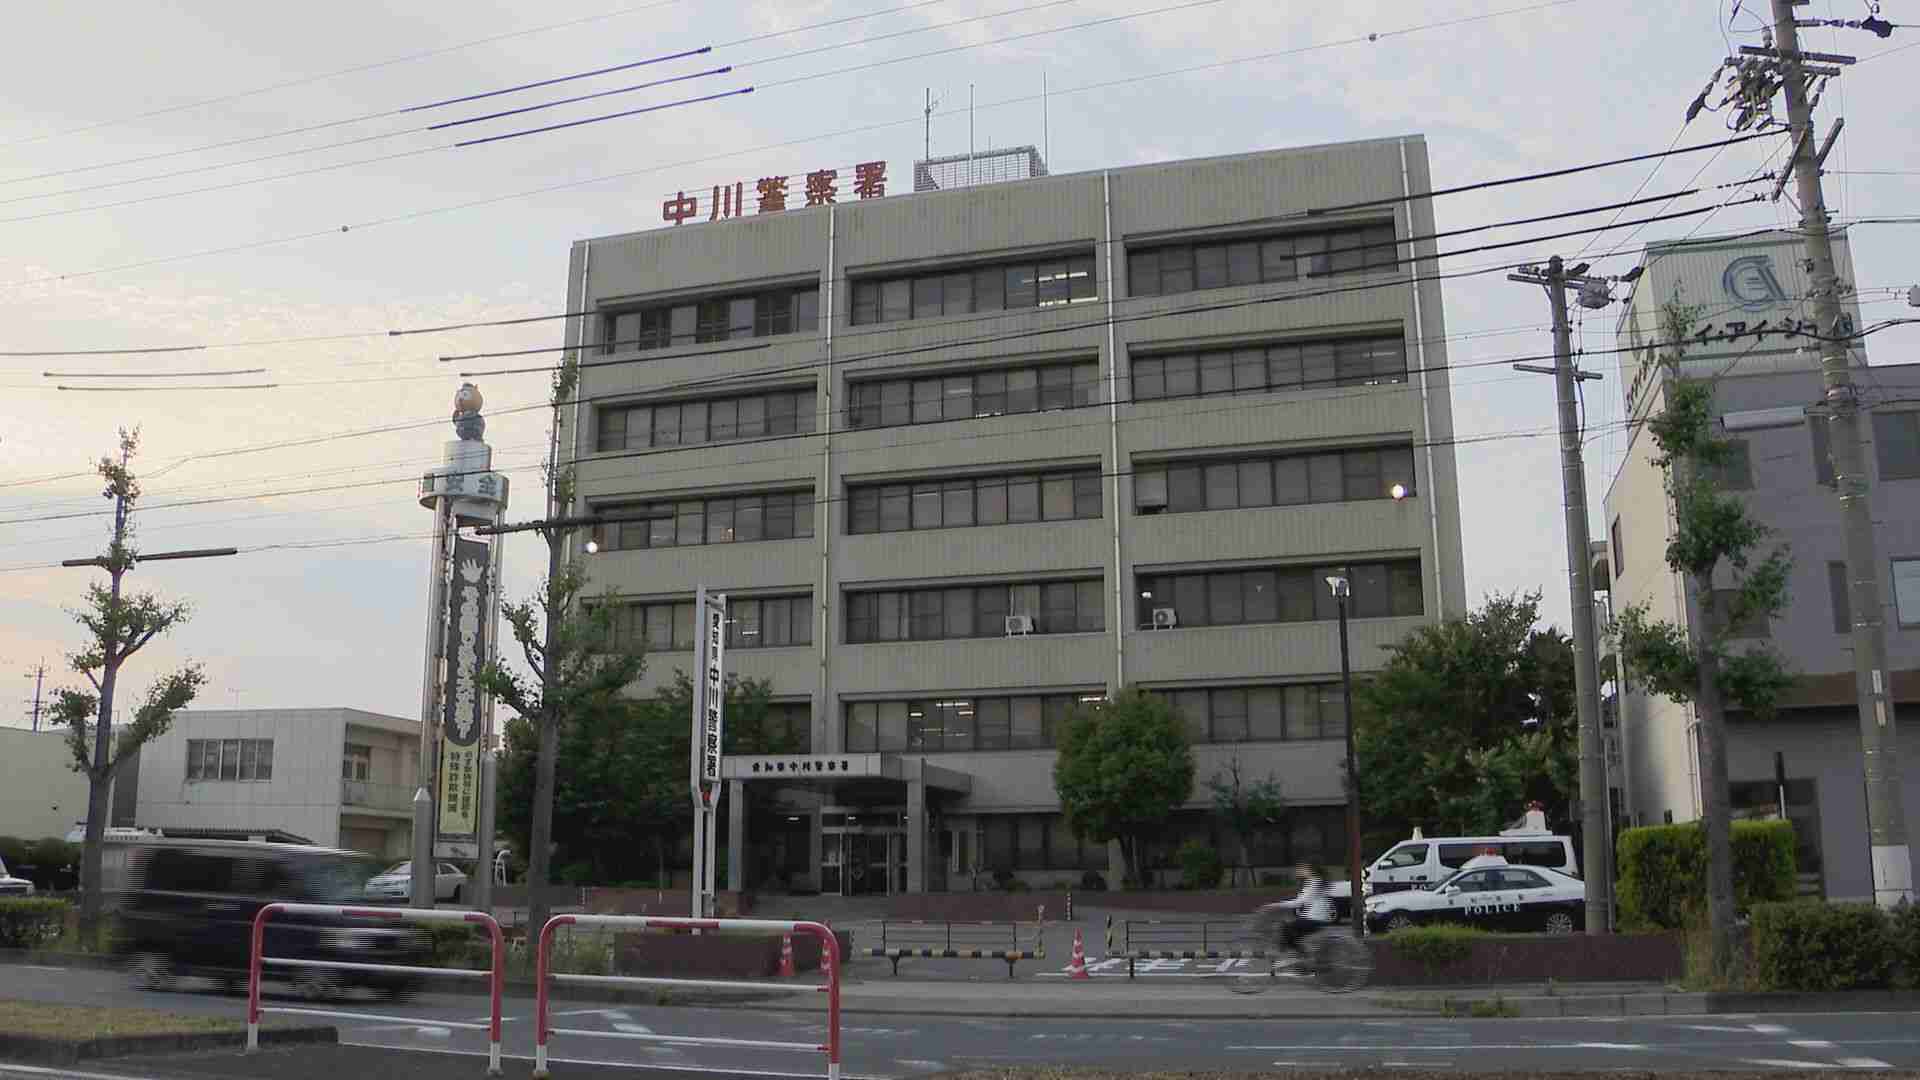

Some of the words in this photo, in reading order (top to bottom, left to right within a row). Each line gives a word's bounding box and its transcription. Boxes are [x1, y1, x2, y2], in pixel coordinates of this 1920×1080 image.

[663, 160, 887, 225] 中川警察署
[1464, 903, 1521, 916] POLICE
